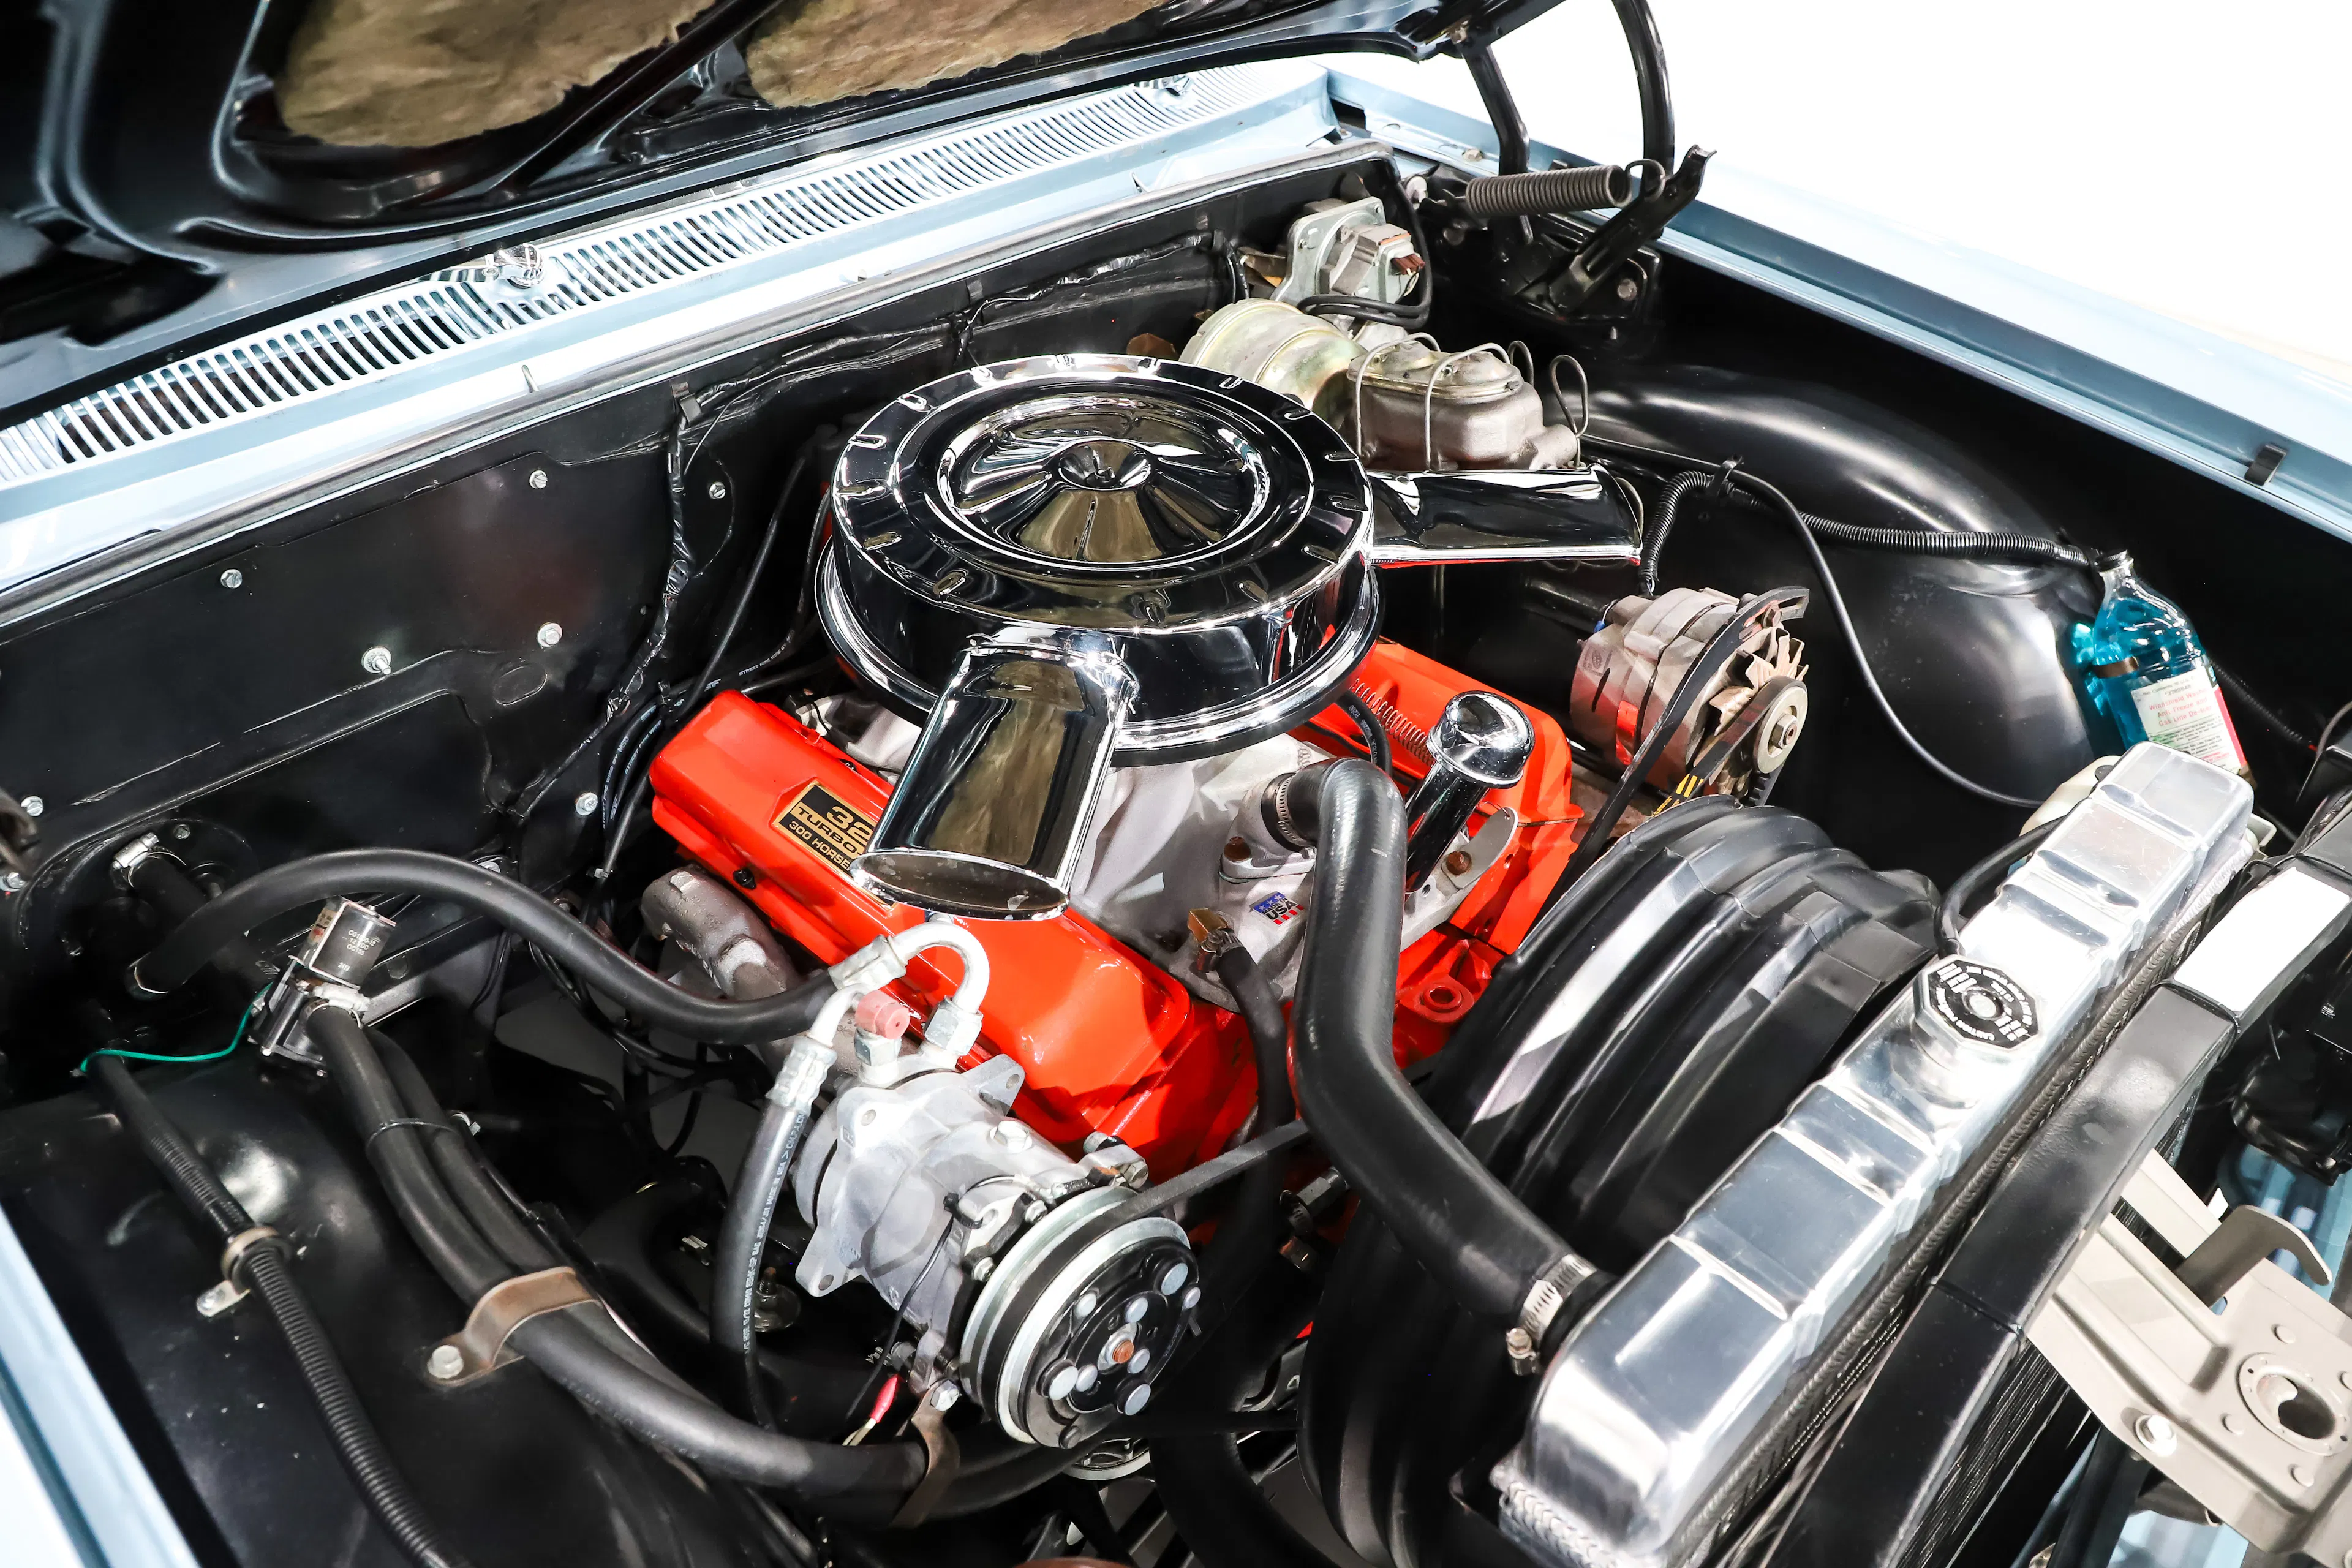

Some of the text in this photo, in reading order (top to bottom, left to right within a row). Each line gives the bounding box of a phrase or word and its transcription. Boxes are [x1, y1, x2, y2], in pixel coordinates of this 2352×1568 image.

[739, 664, 759, 676] STREET
[770, 649, 782, 660] WIRE
[2149, 695, 2184, 710] Windshield
[2158, 718, 2172, 727] Gas
[2174, 714, 2187, 723] Line
[612, 753, 619, 765] BY
[617, 736, 630, 753] MSD
[625, 748, 639, 775] STREET
[799, 806, 862, 856] TURBO-
[827, 806, 873, 847] 32
[789, 821, 851, 871] 300 HORSE
[1261, 902, 1281, 915] MADE
[1265, 900, 1297, 920] USA
[1956, 1019, 1995, 1041] CAUTION
